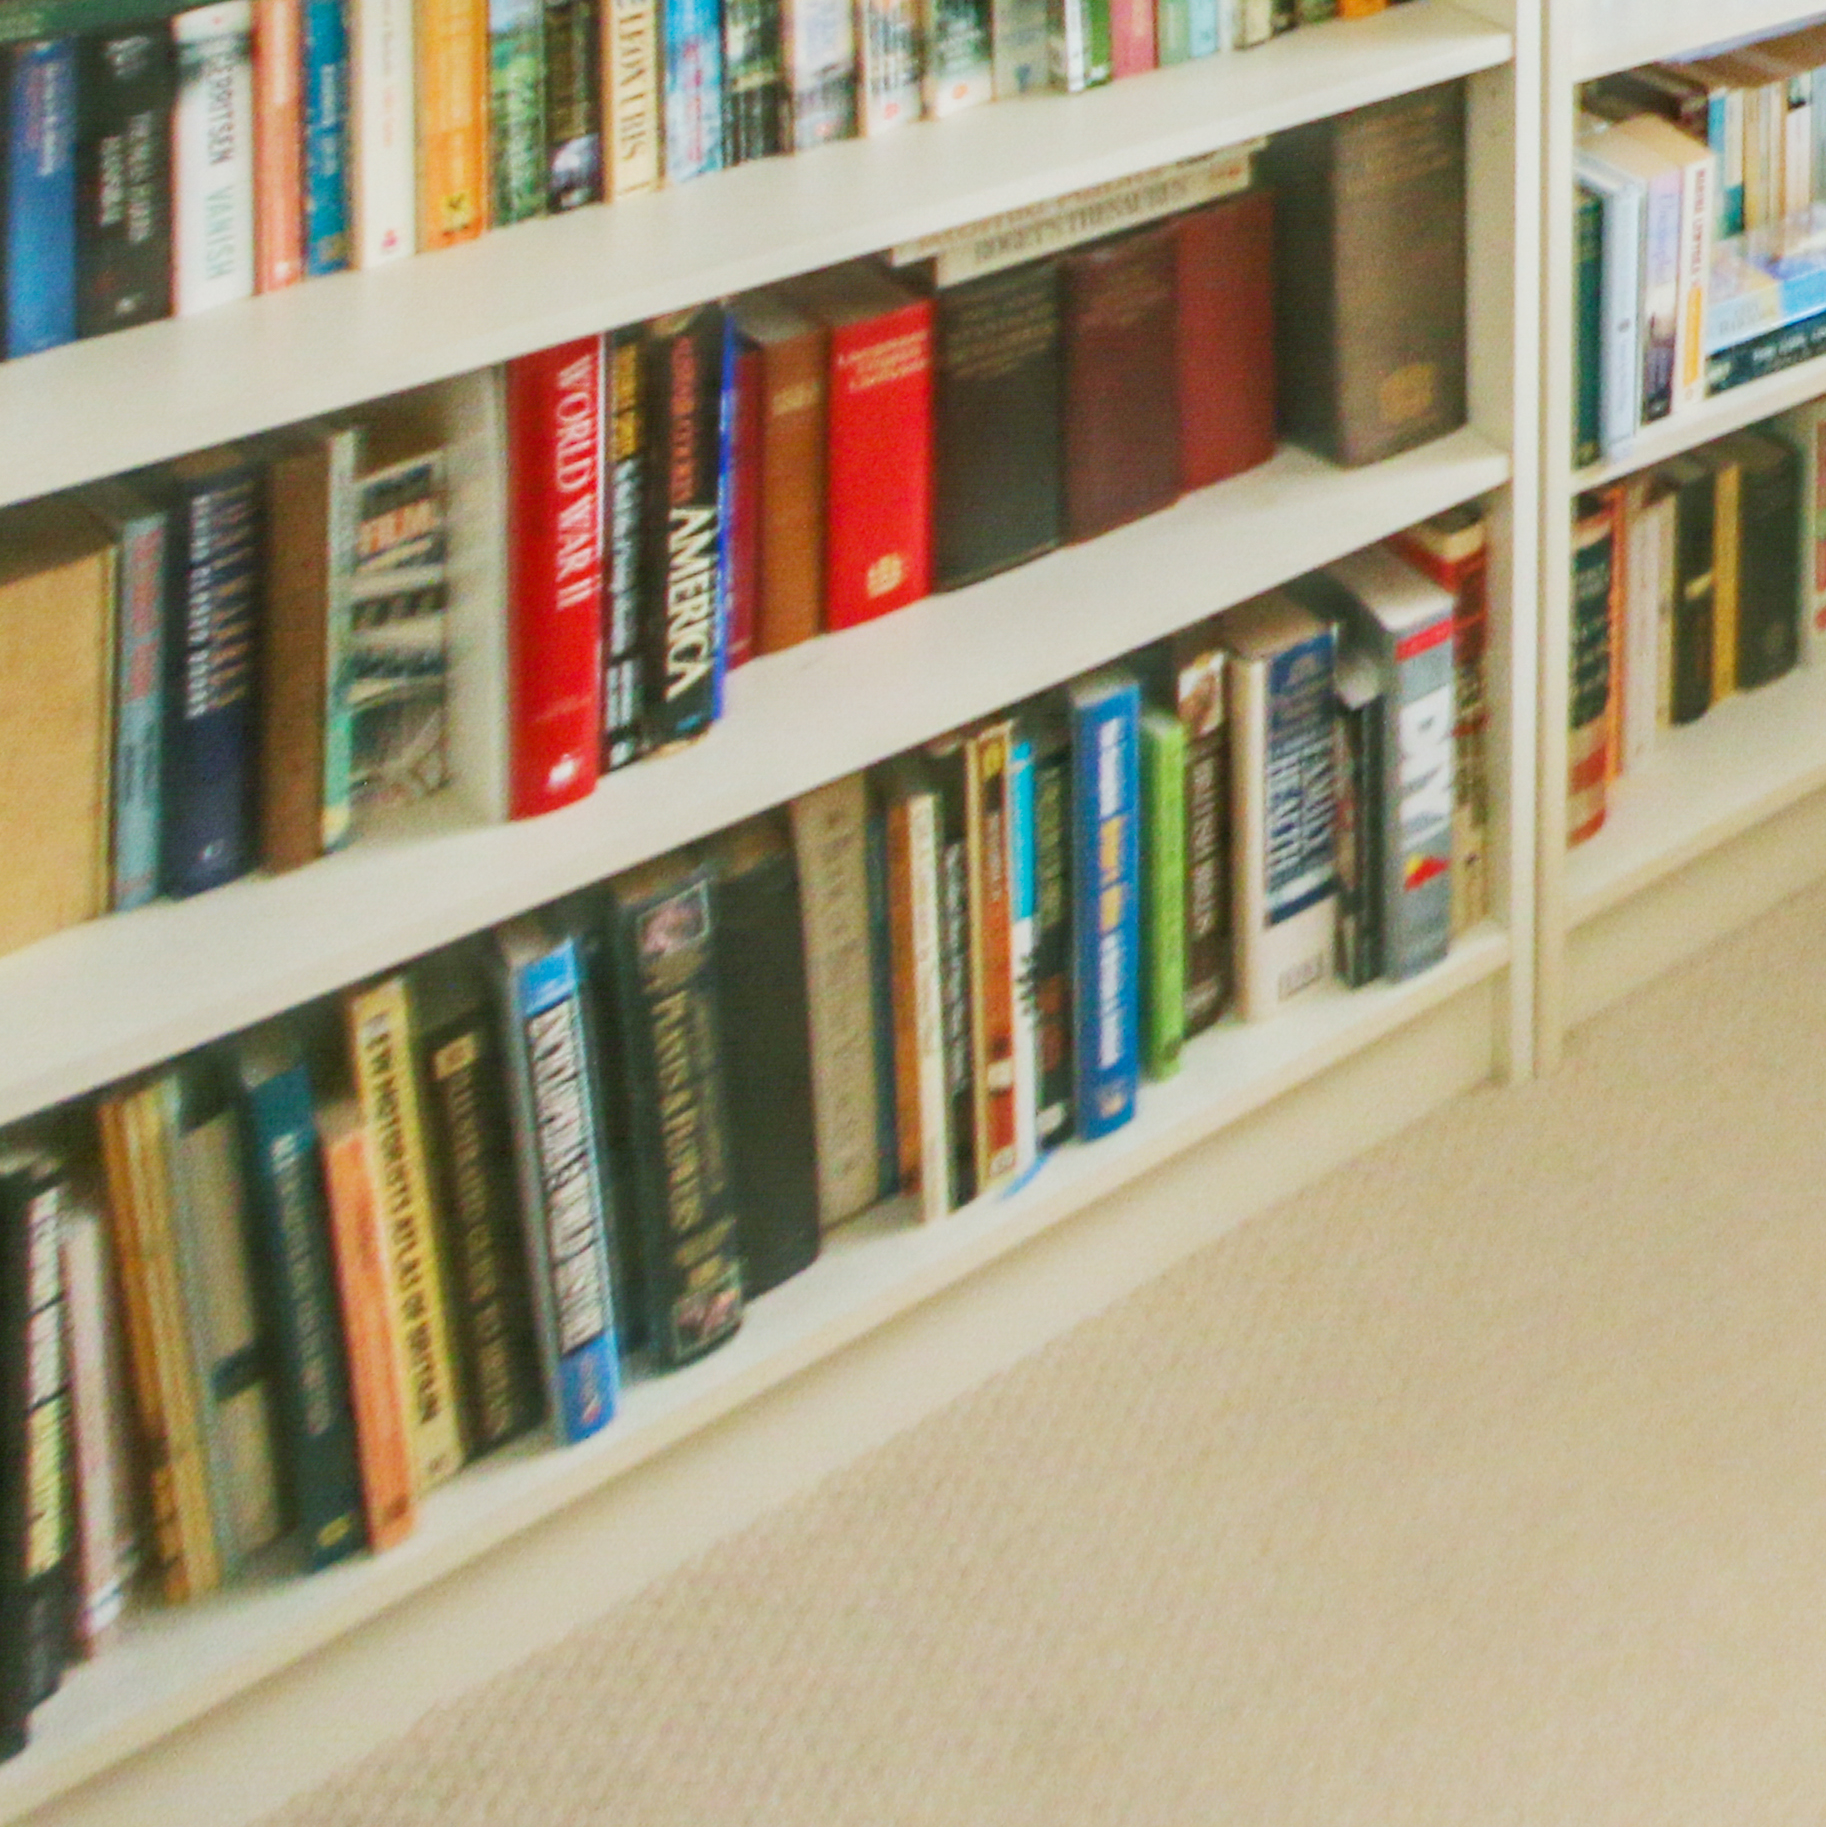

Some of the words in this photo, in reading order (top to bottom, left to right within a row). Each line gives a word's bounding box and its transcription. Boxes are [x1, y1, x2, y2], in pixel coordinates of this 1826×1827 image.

[616, 9, 650, 90] LEON
[617, 92, 650, 162] URIS
[205, 183, 236, 280] VANISH
[555, 352, 595, 495] WORLD
[555, 491, 595, 586] WAR
[555, 576, 595, 613] II
[664, 506, 719, 705] AMERICA
